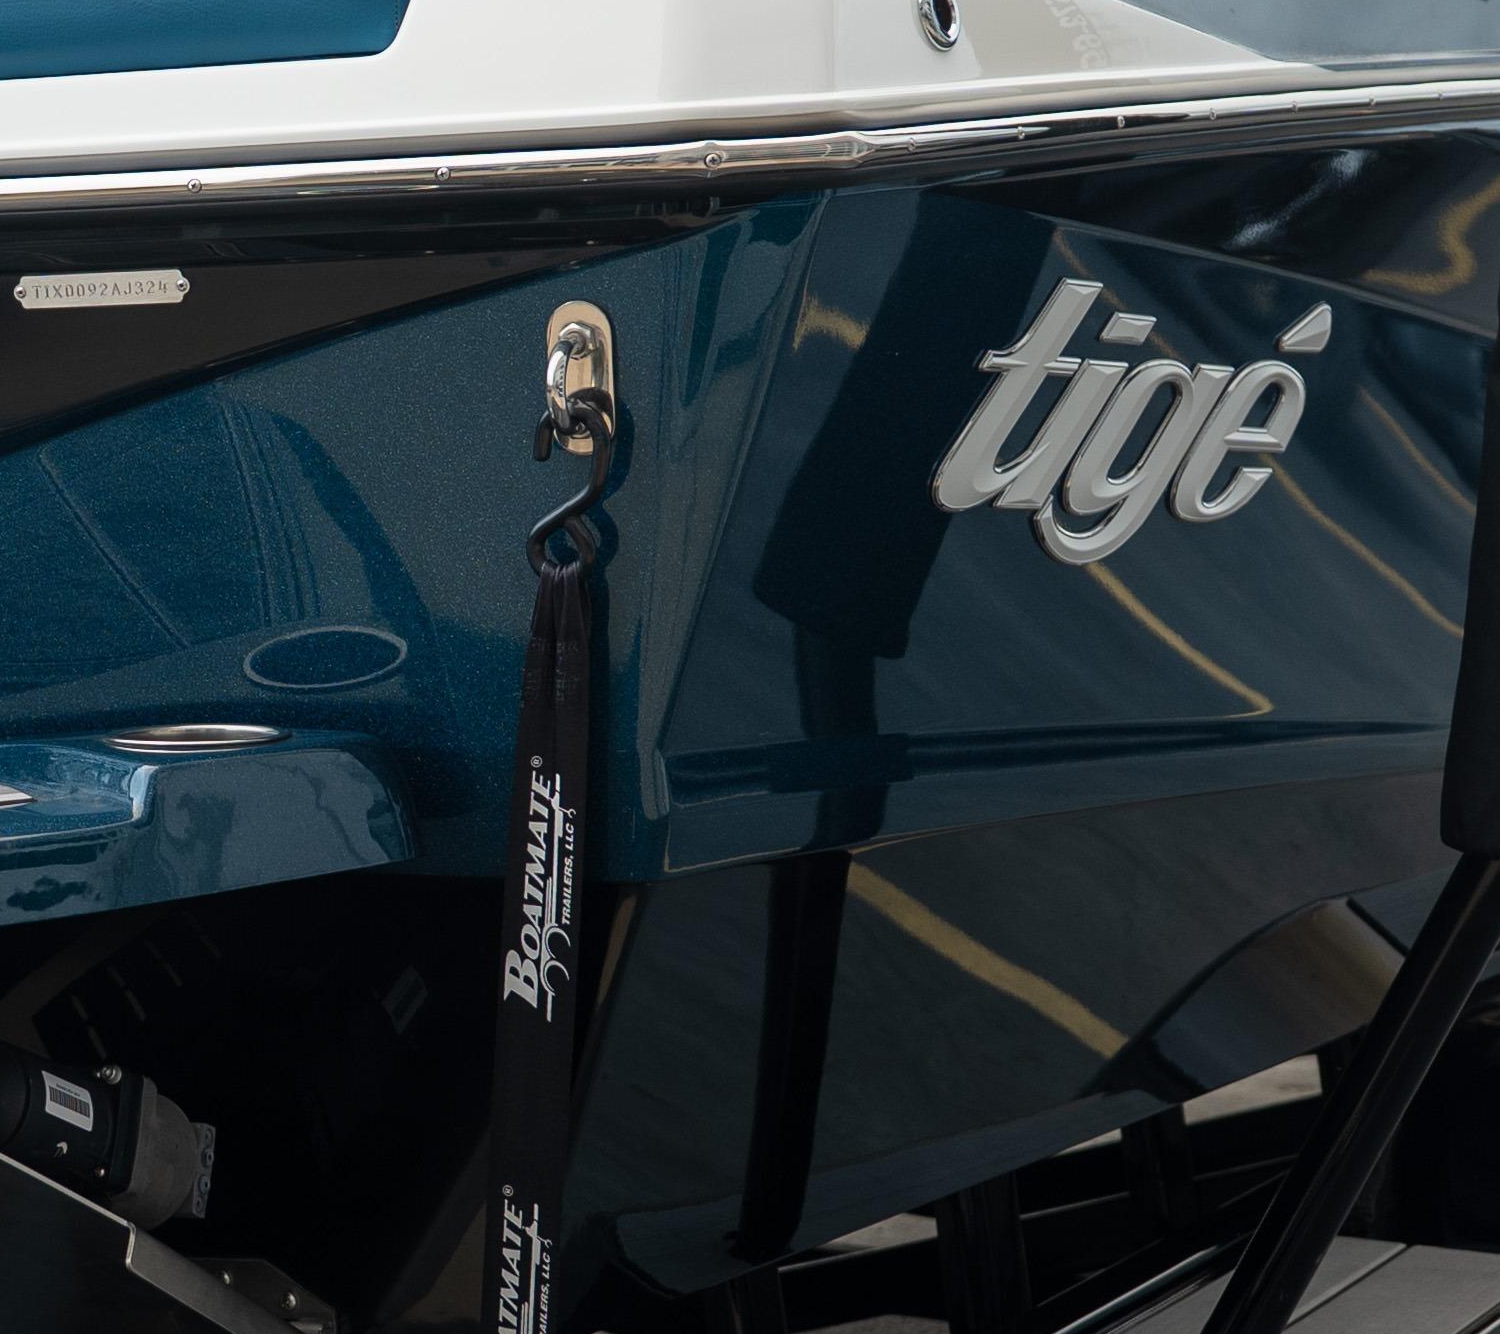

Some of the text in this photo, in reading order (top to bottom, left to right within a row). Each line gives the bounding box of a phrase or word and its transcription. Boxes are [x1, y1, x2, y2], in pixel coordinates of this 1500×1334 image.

[932, 277, 1333, 566] tigé
[565, 823, 576, 850] LLC
[542, 1252, 552, 1279] LLC
